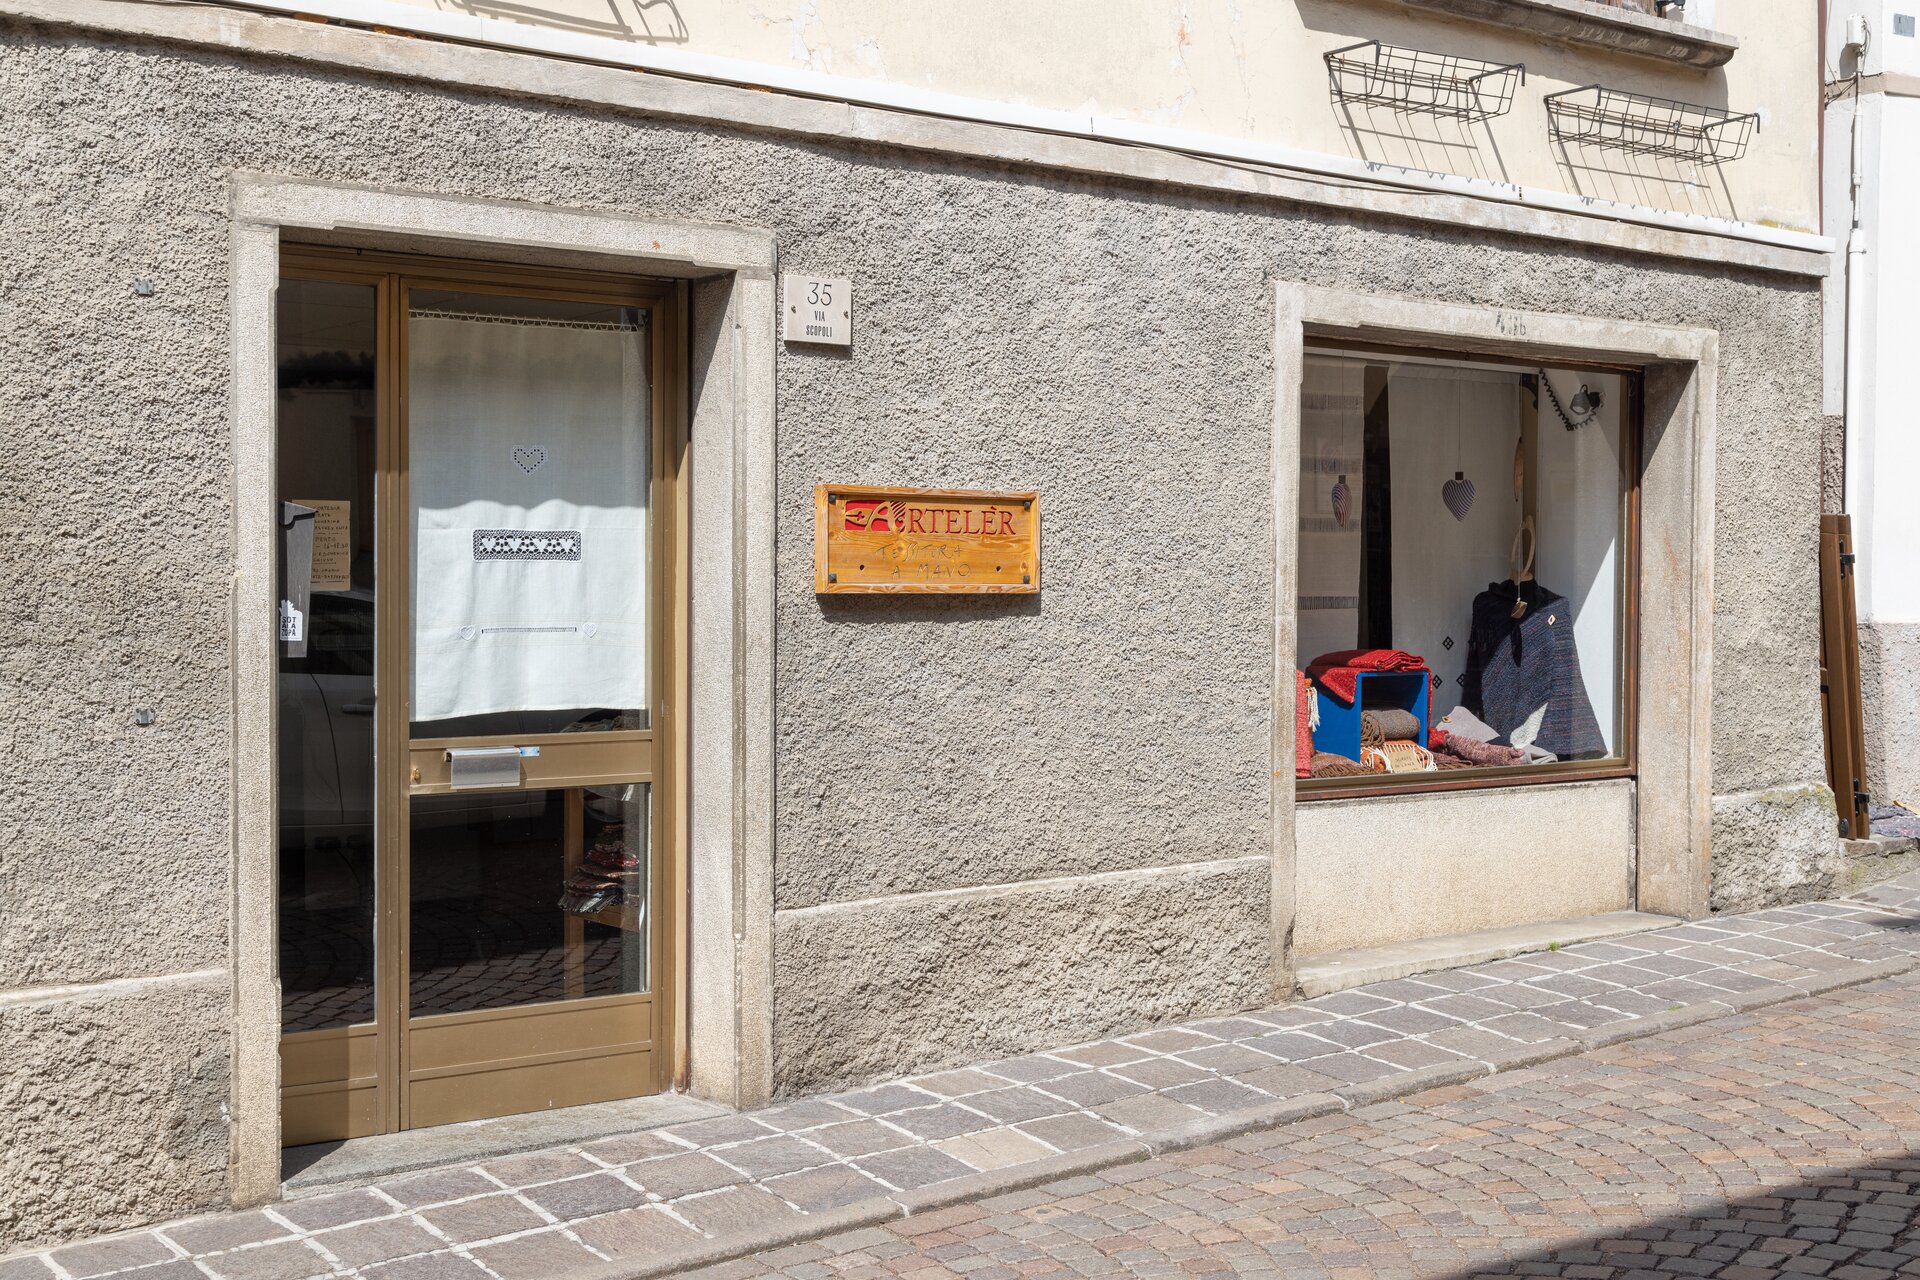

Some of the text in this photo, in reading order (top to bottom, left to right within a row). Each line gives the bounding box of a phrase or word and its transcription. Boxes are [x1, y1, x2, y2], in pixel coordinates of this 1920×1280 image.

[806, 281, 833, 307] 35
[813, 310, 826, 322] VIA
[805, 324, 833, 338] SCOPOLI
[916, 561, 974, 581] MANO
